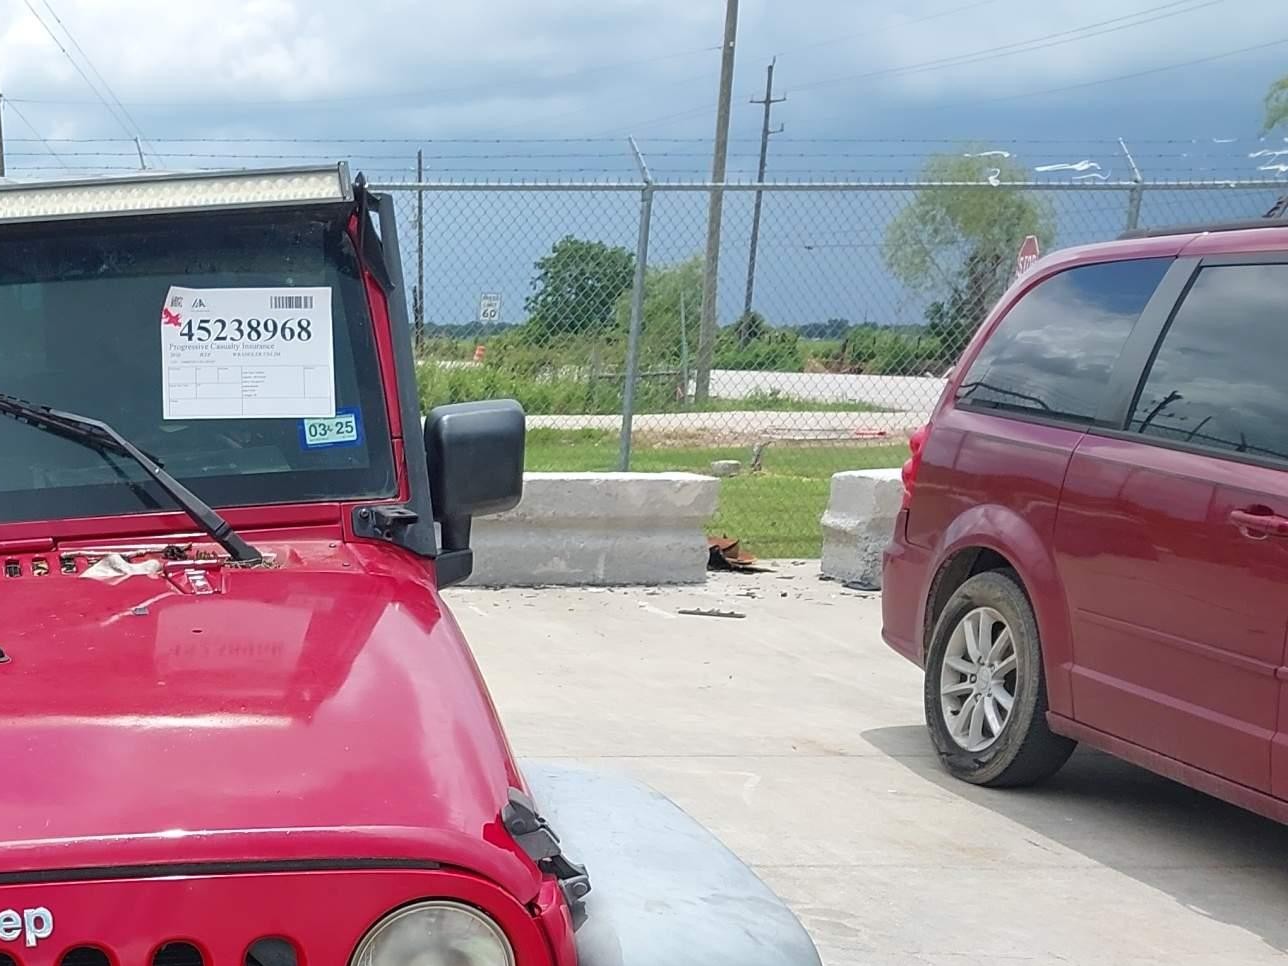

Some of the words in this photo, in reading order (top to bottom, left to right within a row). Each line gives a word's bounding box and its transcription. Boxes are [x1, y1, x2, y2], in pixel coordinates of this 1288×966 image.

[482, 309, 497, 318] 60
[179, 318, 312, 341] 45238968
[169, 343, 209, 352] Progressive
[210, 343, 240, 352] Casualty
[242, 342, 275, 350] Insurance
[308, 422, 328, 438] 03
[335, 420, 355, 435] 25
